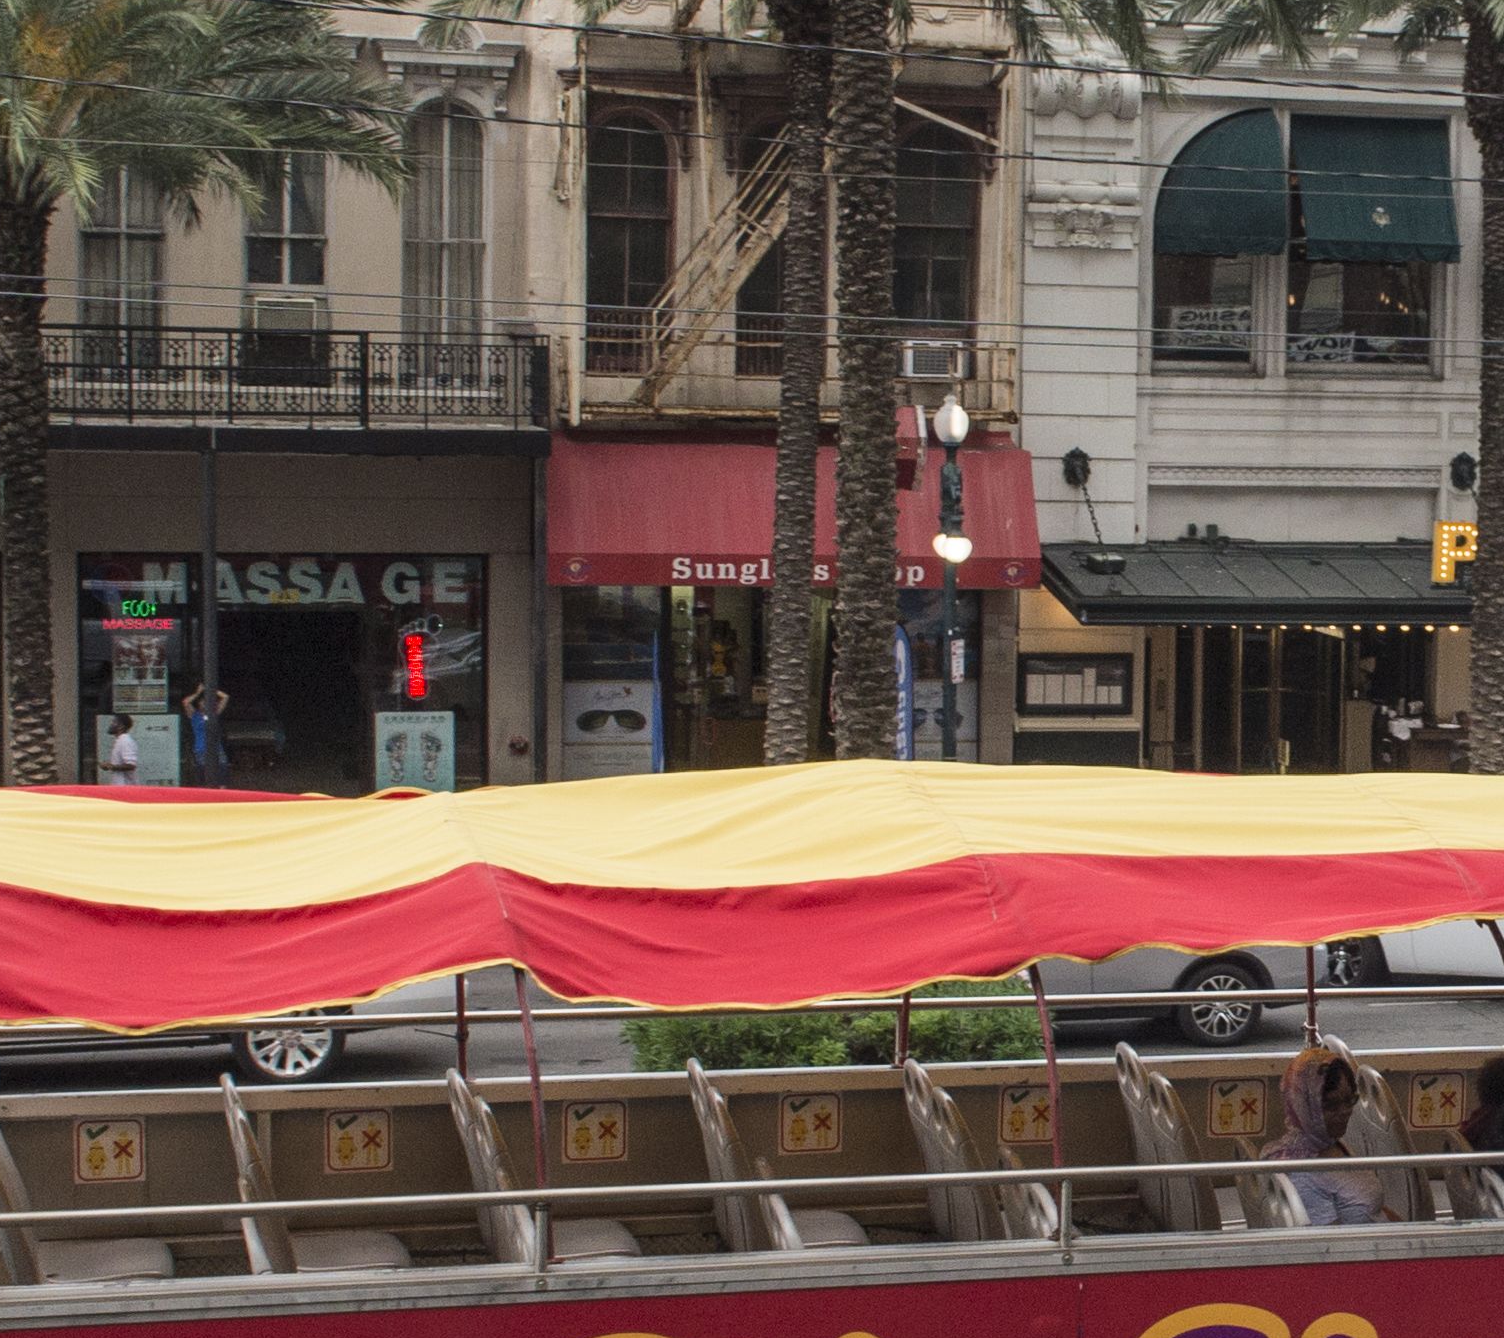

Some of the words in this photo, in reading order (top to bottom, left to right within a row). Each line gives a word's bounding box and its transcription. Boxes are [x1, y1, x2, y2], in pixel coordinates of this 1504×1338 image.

[142, 558, 470, 604] MASSAGE
[671, 557, 829, 585] Sungls
[102, 618, 175, 630] MASSAGE
